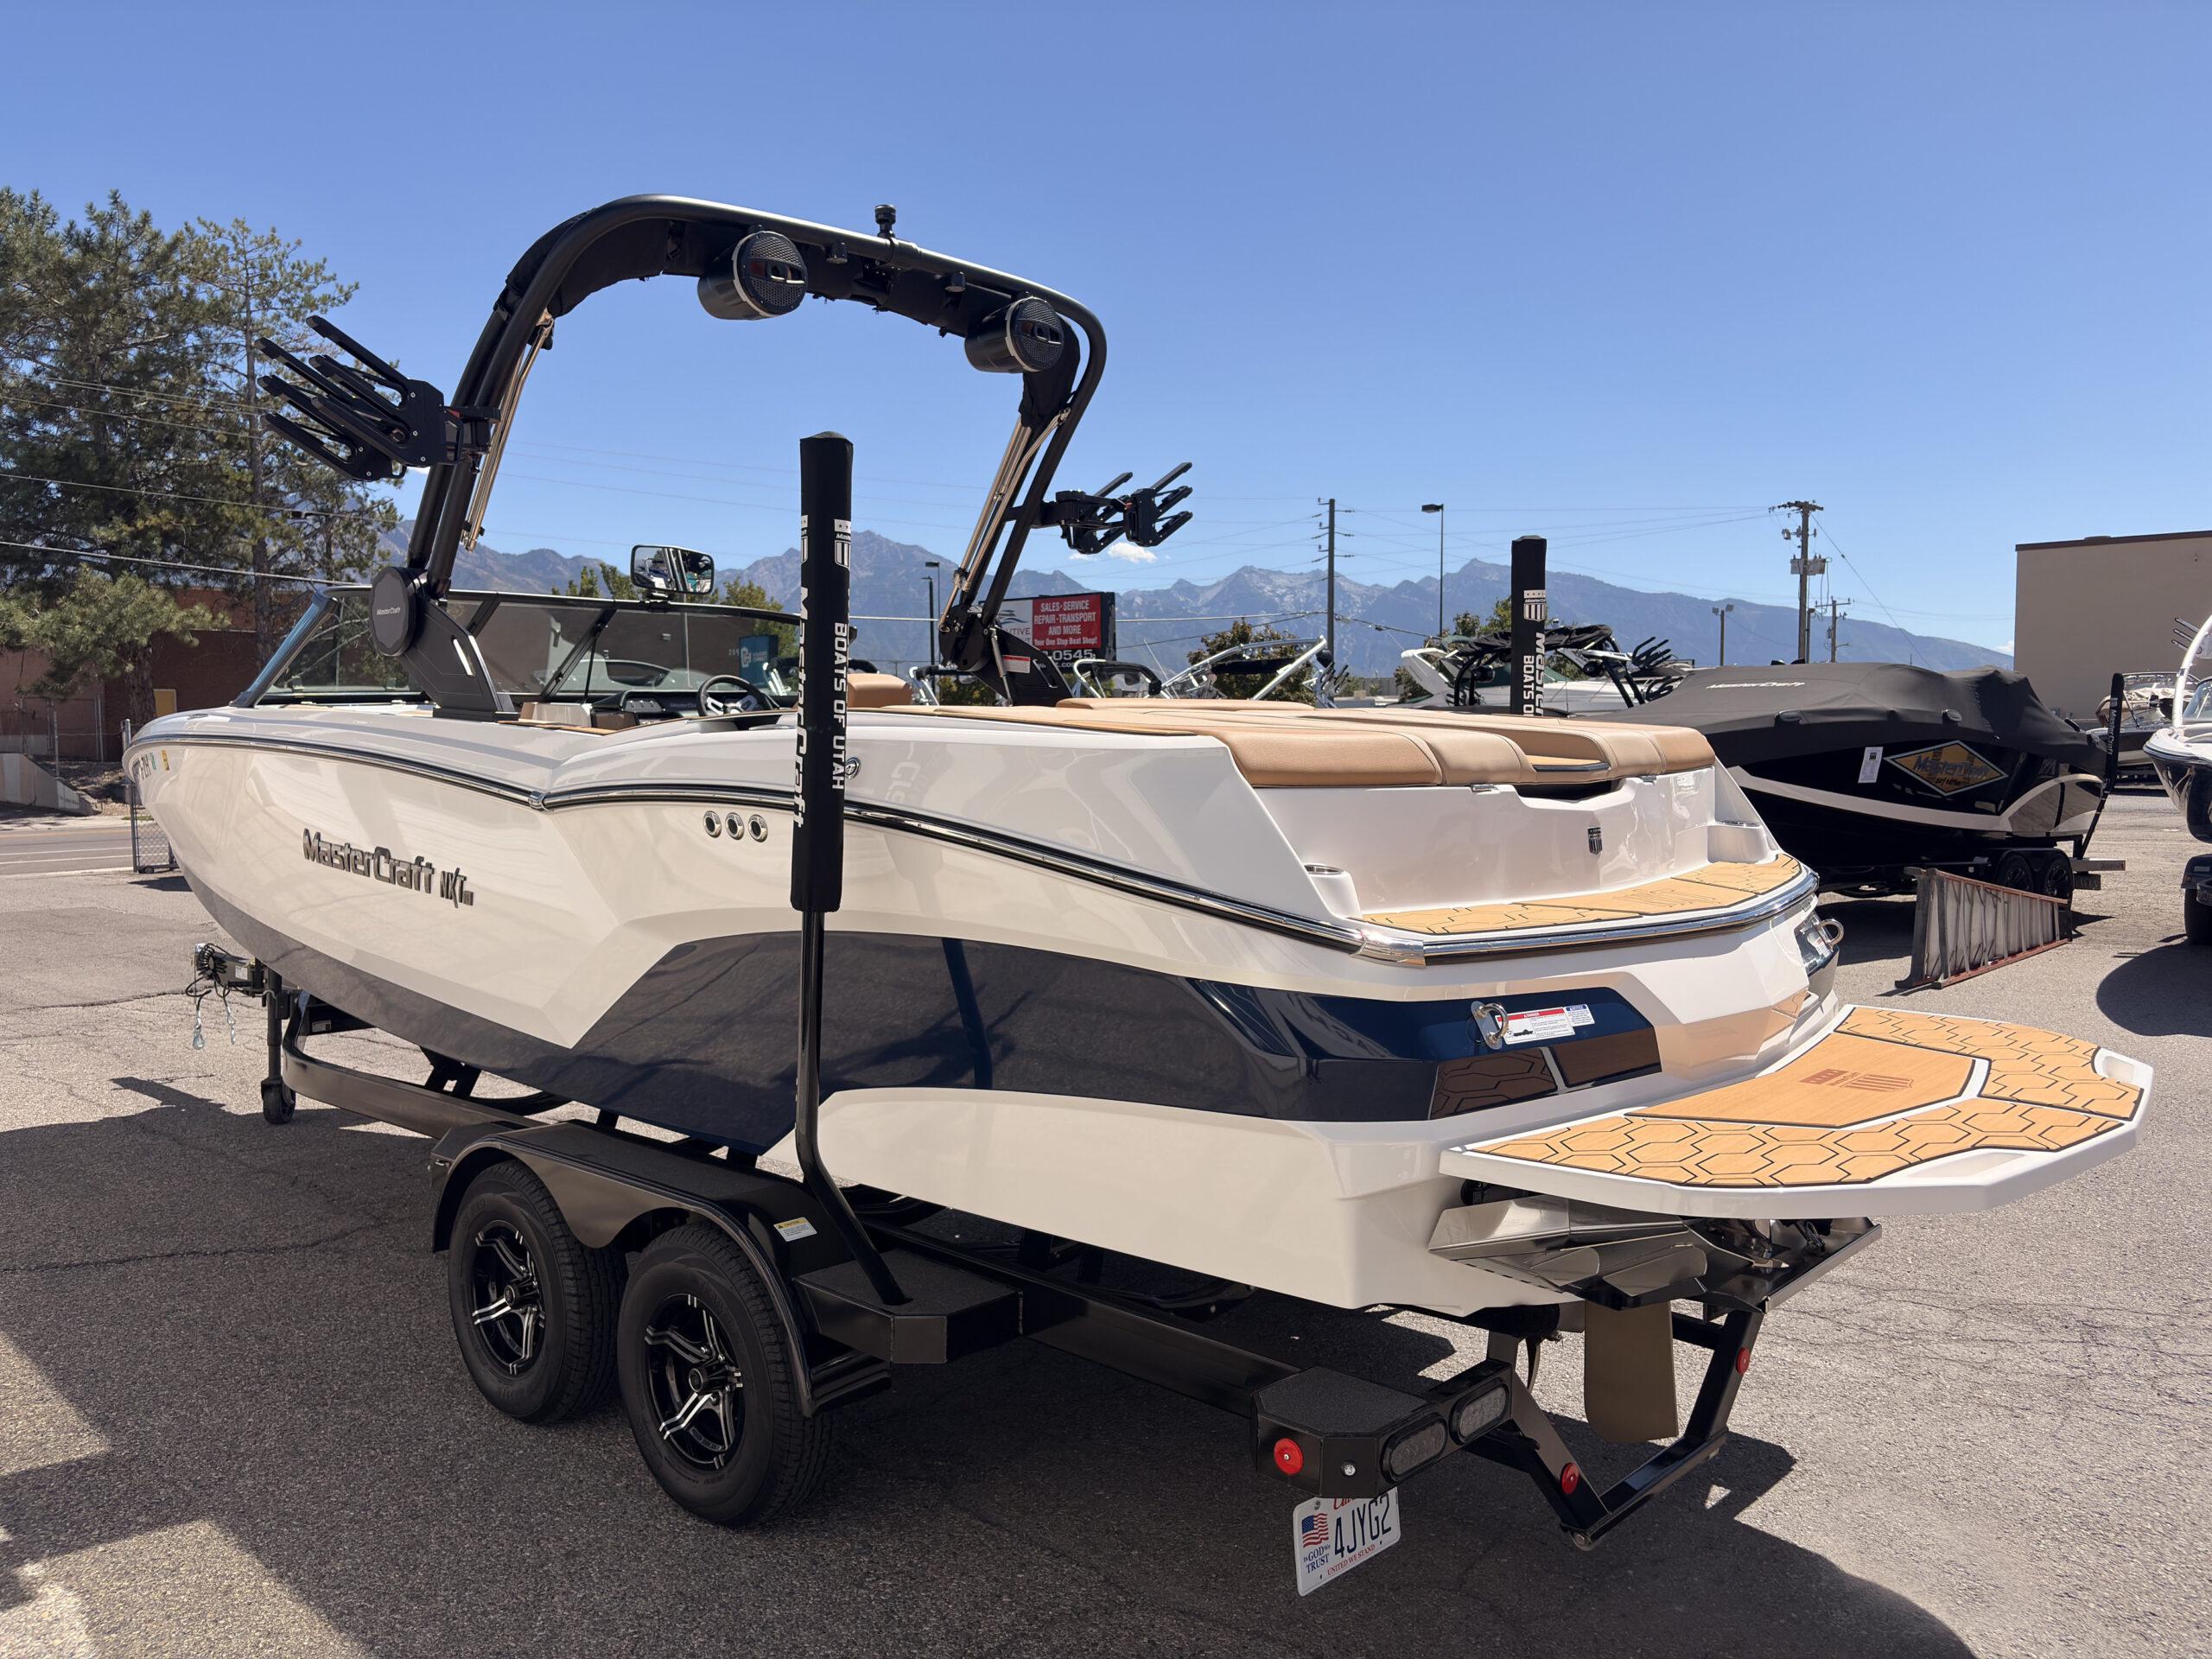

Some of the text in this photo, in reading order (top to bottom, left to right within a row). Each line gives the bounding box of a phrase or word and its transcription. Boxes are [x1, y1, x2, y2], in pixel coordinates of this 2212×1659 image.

[1048, 625, 1082, 636] AND MORE
[1057, 638, 1068, 646] Stop
[1522, 655, 1535, 716] BOATS O
[831, 622, 849, 790] BOATS OF UTAH
[302, 828, 435, 895] MasterCraft
[1334, 1492, 1392, 1559] 4JYG2
[1306, 1553, 1330, 1574] TRUST
[1308, 1546, 1325, 1562] GOD
[1327, 1543, 1376, 1576] UNITED WE STAND
